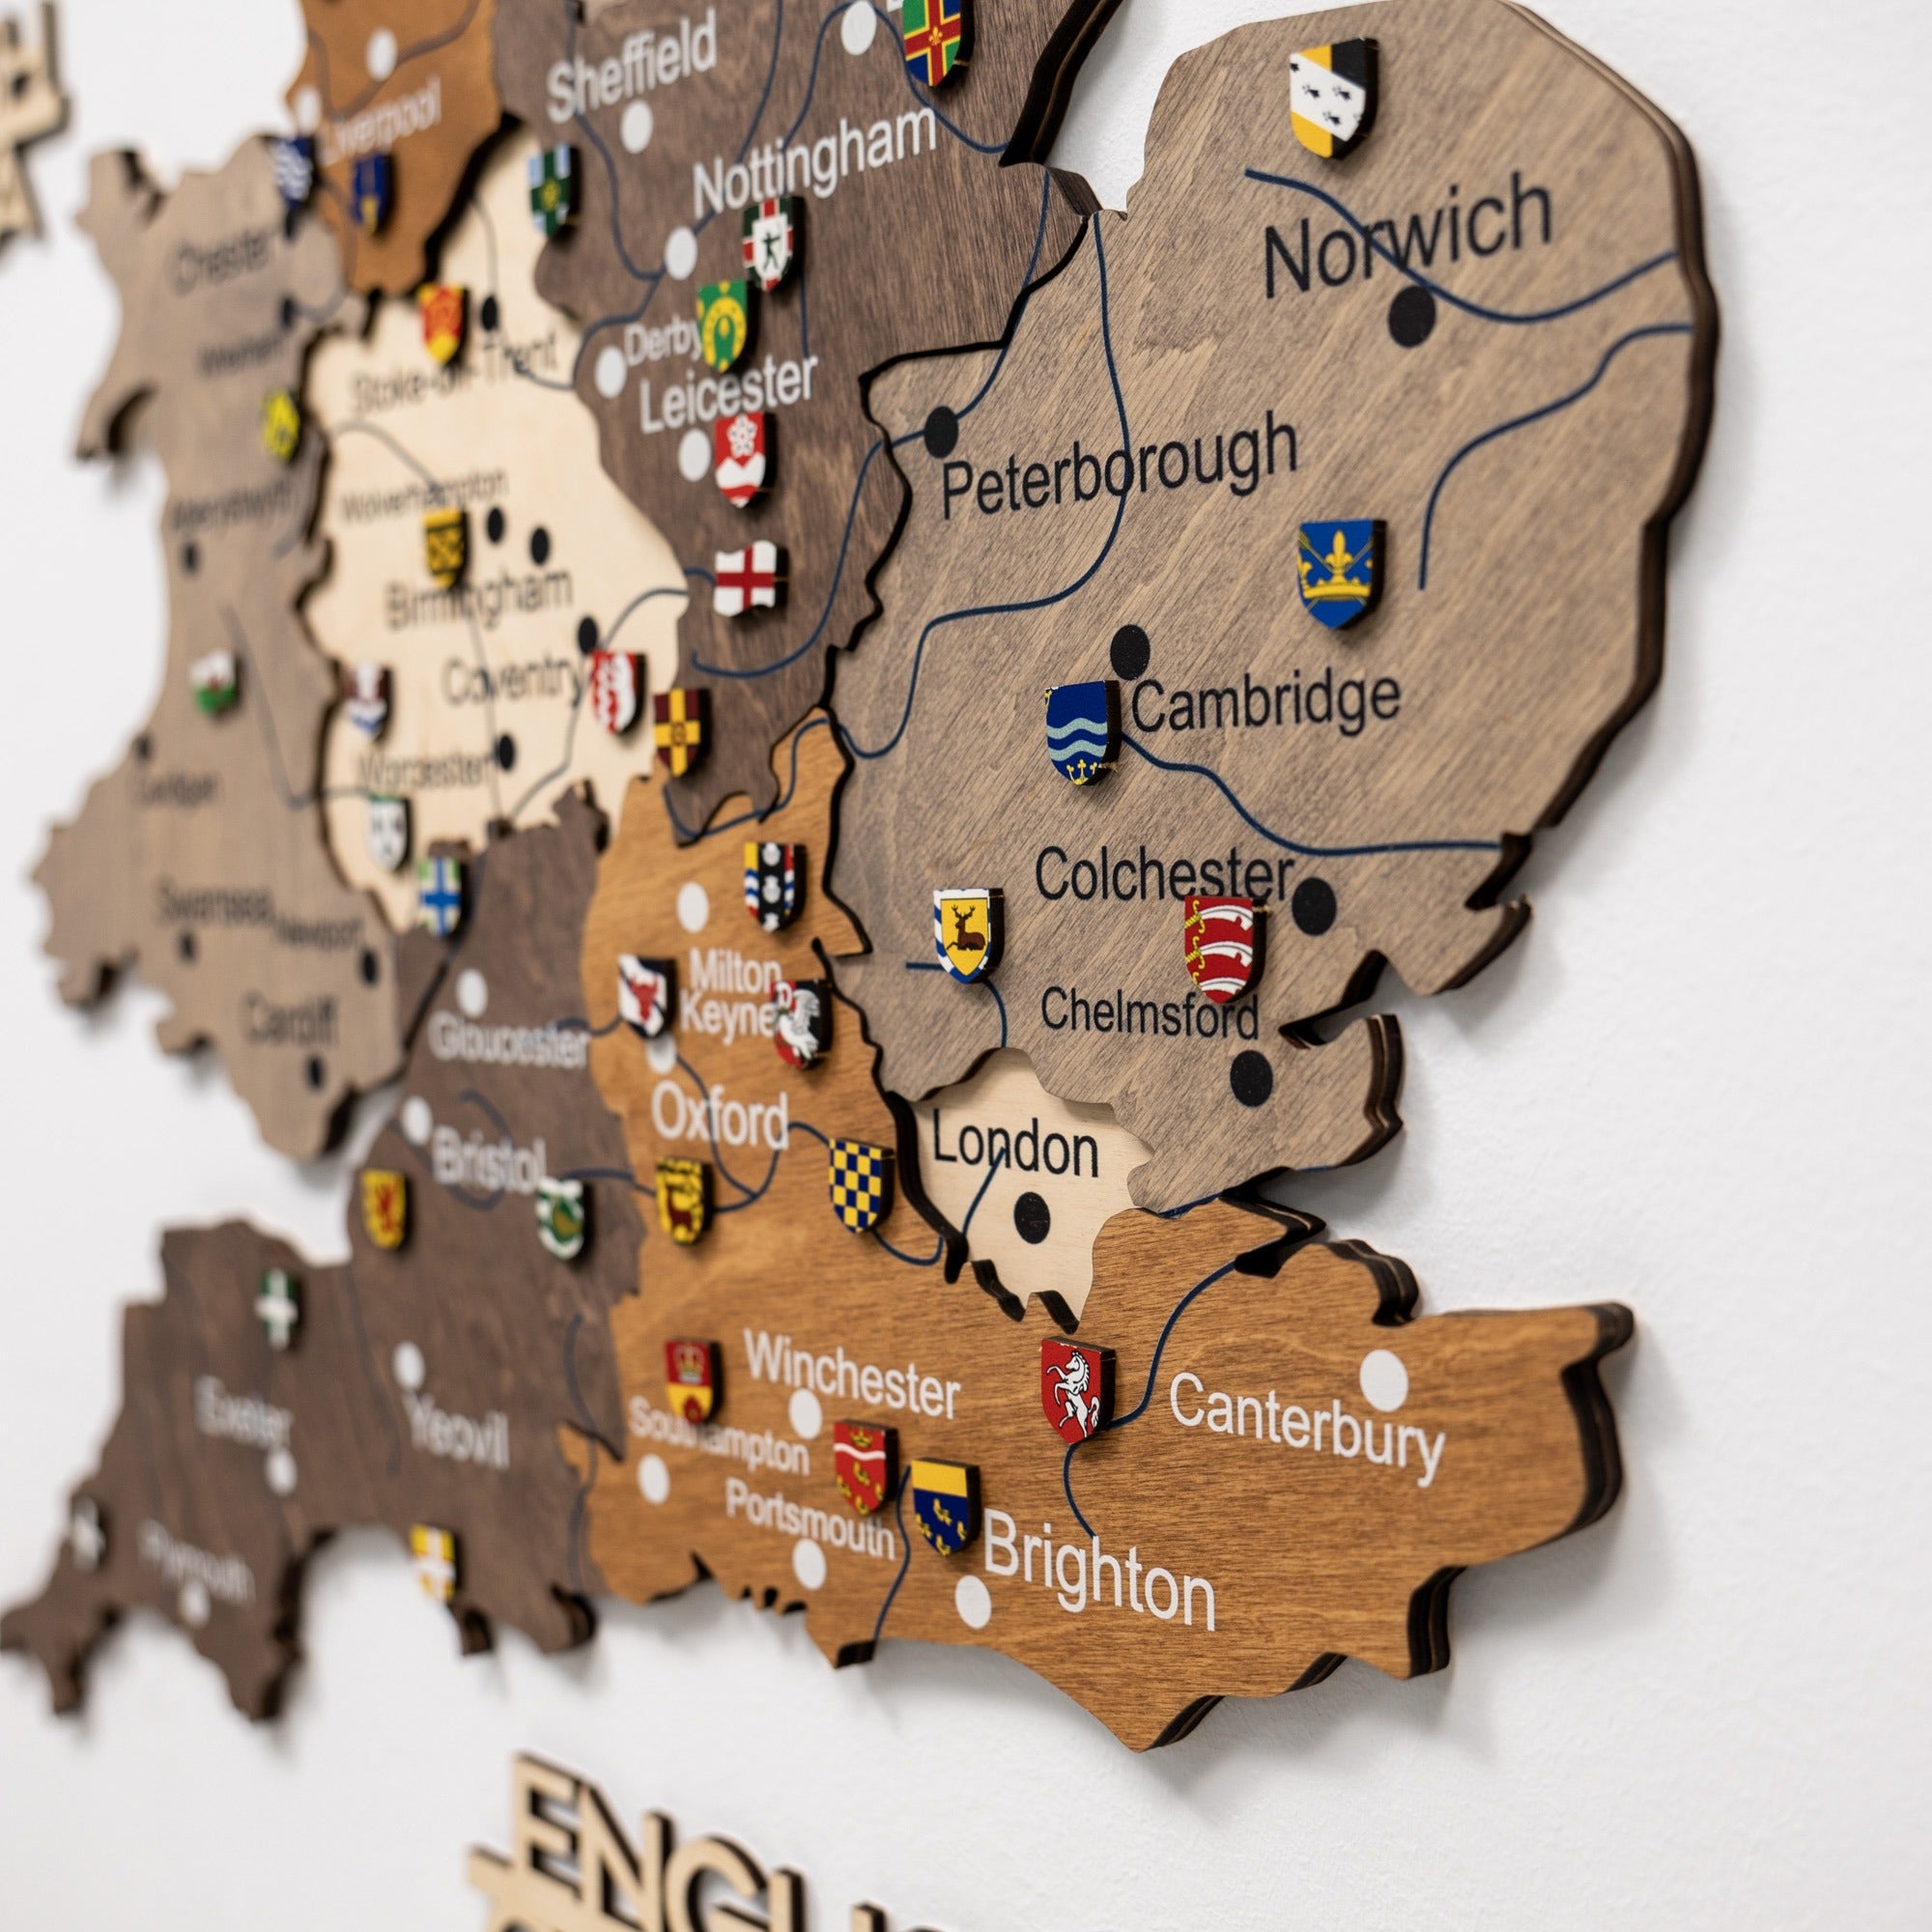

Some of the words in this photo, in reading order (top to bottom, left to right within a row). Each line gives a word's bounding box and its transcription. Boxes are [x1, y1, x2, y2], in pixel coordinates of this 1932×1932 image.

[547, 6, 717, 124] Sheffield
[694, 107, 937, 218] Nottingham
[1264, 171, 1551, 298] Norwich
[624, 313, 703, 367] Derby
[640, 354, 819, 435] Leicester
[941, 409, 1298, 521] Peterborough
[384, 567, 574, 633] Birmingham
[440, 651, 582, 709] Coventry
[1131, 667, 1402, 737] Cambridge
[1036, 844, 1295, 902] Colchester
[688, 946, 782, 995] Milton
[427, 1009, 591, 1070] Gloucester
[678, 986, 778, 1046] Keyne
[1040, 984, 1260, 1041] Chelmsford
[651, 1078, 790, 1151] Oxford
[933, 1107, 1099, 1178] London
[433, 1124, 547, 1196] Bristol
[743, 1327, 962, 1420] Winchester
[1170, 1371, 1446, 1489] Canterbury
[725, 1476, 896, 1562] Portsmouth
[983, 1508, 1216, 1633] Brighton
